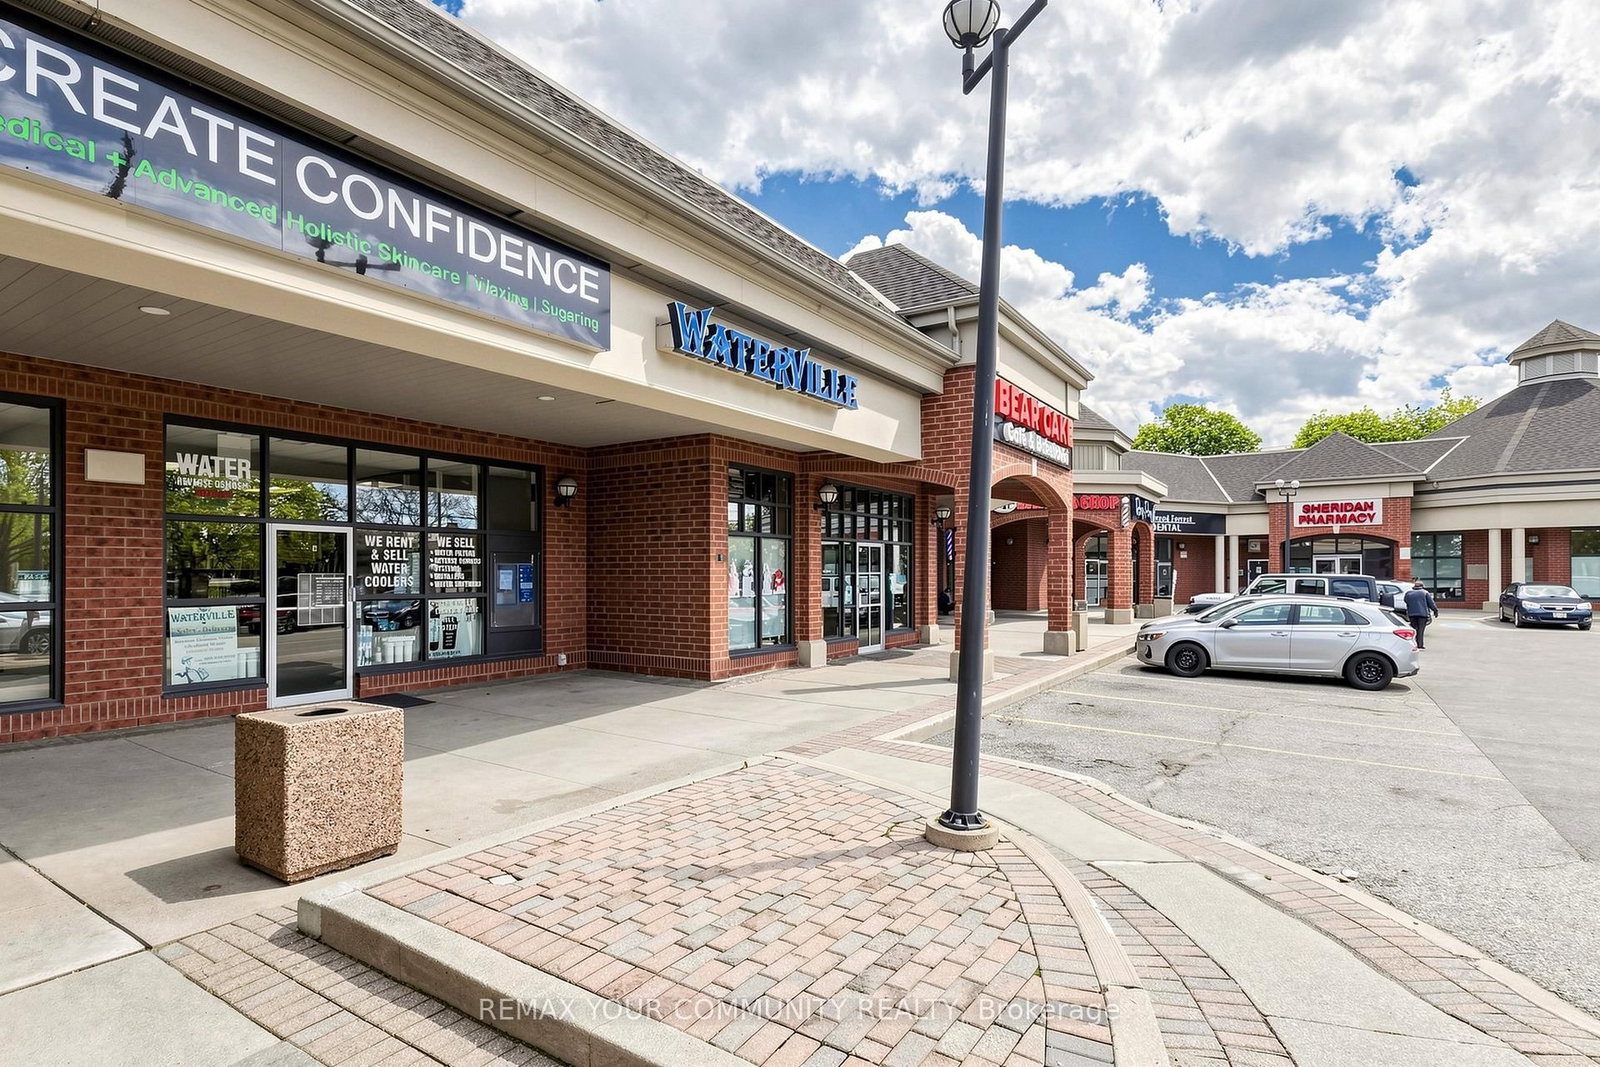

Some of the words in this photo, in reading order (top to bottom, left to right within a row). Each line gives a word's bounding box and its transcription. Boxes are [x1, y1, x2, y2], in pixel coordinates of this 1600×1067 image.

[0, 115, 96, 163] dical
[134, 159, 277, 225] Advanced
[286, 210, 373, 255] Holistic
[377, 242, 461, 285] Skincare
[541, 299, 600, 333] Sugaring
[295, 155, 600, 304] CONFIDENCE
[668, 301, 859, 410] WATERVILLE
[996, 379, 1040, 431] BEAR
[176, 452, 251, 480] WATER
[1302, 502, 1374, 513] SHERIDAN
[1298, 512, 1376, 525] PHARMACY
[364, 535, 383, 547] WE
[386, 536, 414, 548] RENT
[436, 536, 452, 548] WE
[454, 537, 475, 549] SELL
[370, 549, 379, 560] &
[383, 549, 409, 561] SELL
[371, 562, 408, 574] WATER
[364, 575, 414, 588] COOLERS
[170, 609, 236, 623] WATERVILLE
